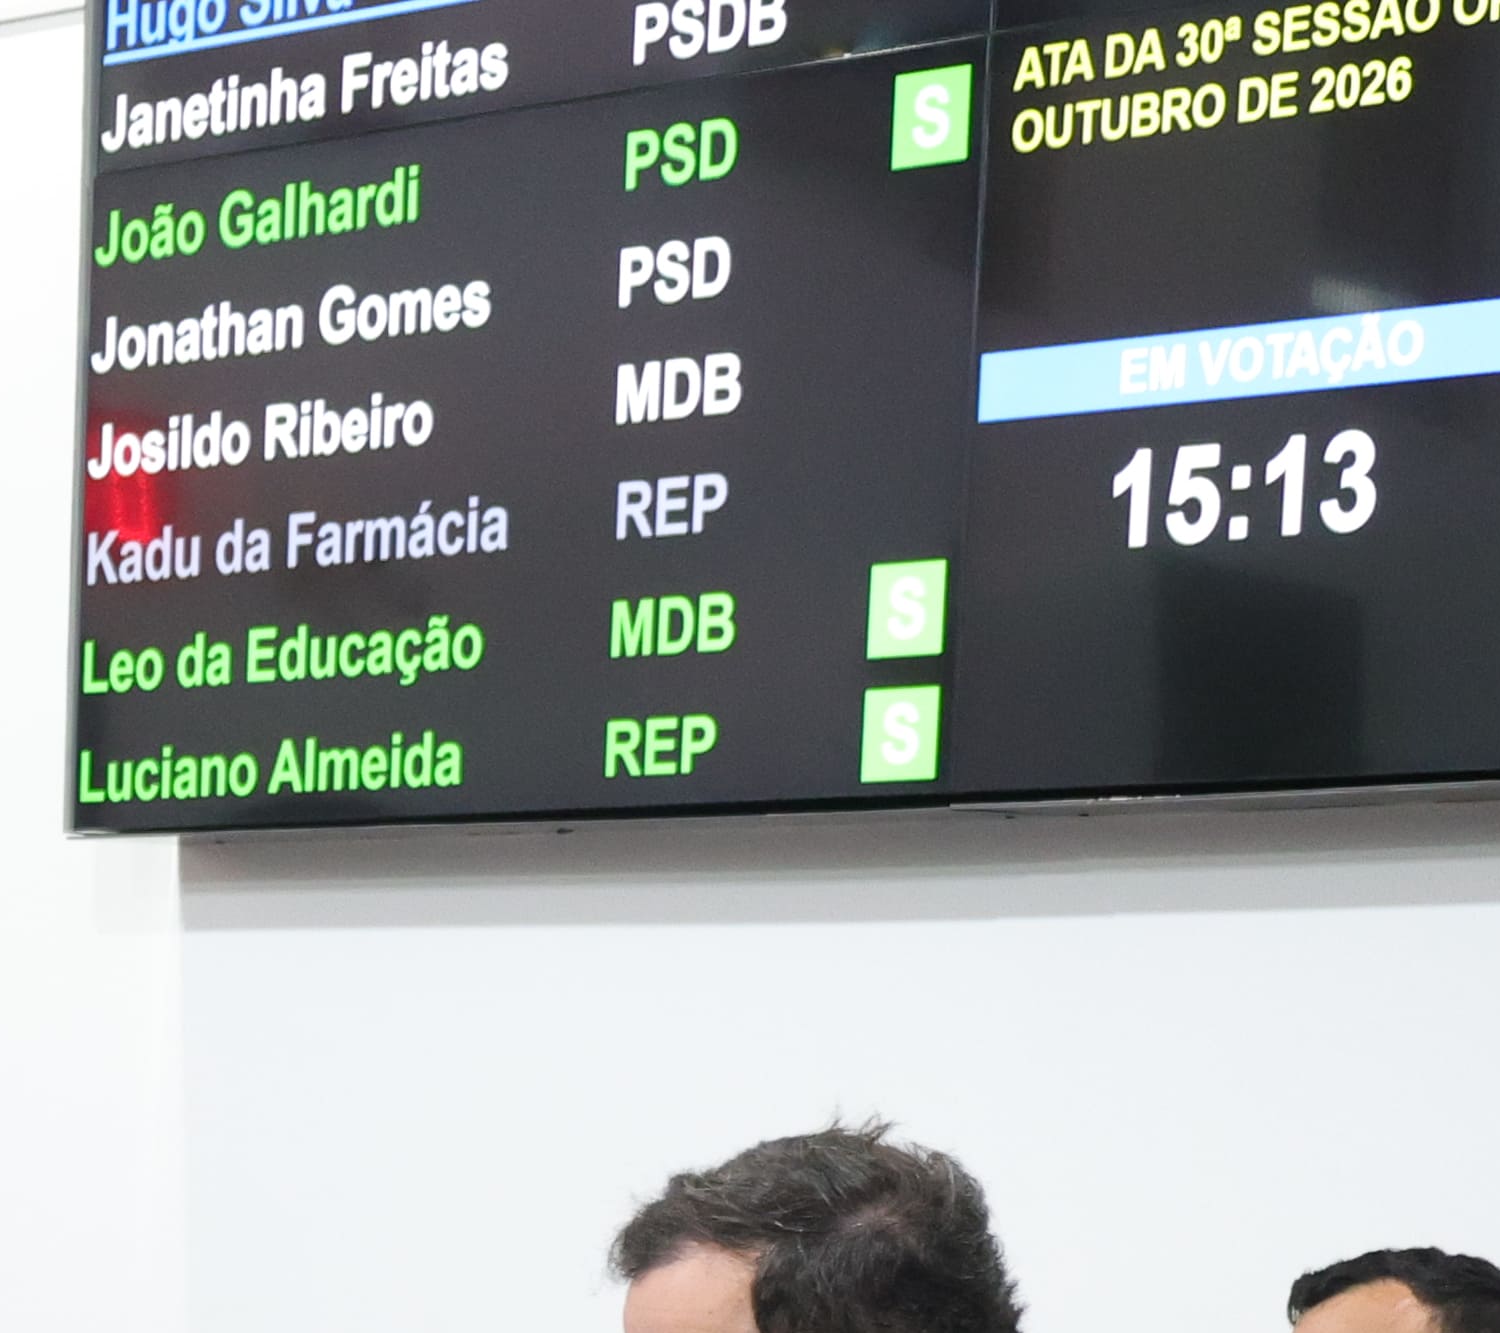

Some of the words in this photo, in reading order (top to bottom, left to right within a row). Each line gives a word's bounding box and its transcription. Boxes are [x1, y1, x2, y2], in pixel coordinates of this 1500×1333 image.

[106, 0, 227, 49] Hugo
[633, 0, 787, 65] PSDB
[1014, 39, 1094, 91] ATA
[1105, 29, 1165, 78] DA
[101, 67, 326, 152] Janetinha
[341, 40, 508, 113] Freitas
[911, 83, 951, 149] S
[1012, 83, 1226, 152] OUTUBRO
[1238, 72, 1298, 123] DE
[1309, 56, 1412, 113] 2026
[625, 118, 737, 191] PSD
[95, 204, 205, 267] João
[219, 165, 419, 248] Galhardi
[619, 236, 731, 308] PSD
[91, 301, 304, 373] Jonathan
[319, 280, 491, 345] Gomes
[1120, 335, 1184, 396] EM
[1201, 312, 1425, 386] VOTAÇÃO
[616, 352, 742, 424] MDB
[86, 411, 251, 480] Josildo
[264, 392, 433, 460] Ribeiro
[616, 473, 728, 539] REP
[1113, 429, 1376, 548] 15:13
[86, 525, 200, 585] Kadu
[216, 519, 270, 574] da
[288, 496, 508, 568] Farmácia
[611, 592, 735, 658] MDB
[886, 578, 925, 641] S
[83, 641, 164, 693] Leo
[177, 632, 231, 688] da
[247, 615, 483, 685] Educação
[80, 746, 258, 802] Luciano
[268, 731, 461, 793] Almeida
[605, 715, 717, 777] REP
[880, 700, 919, 765] S
